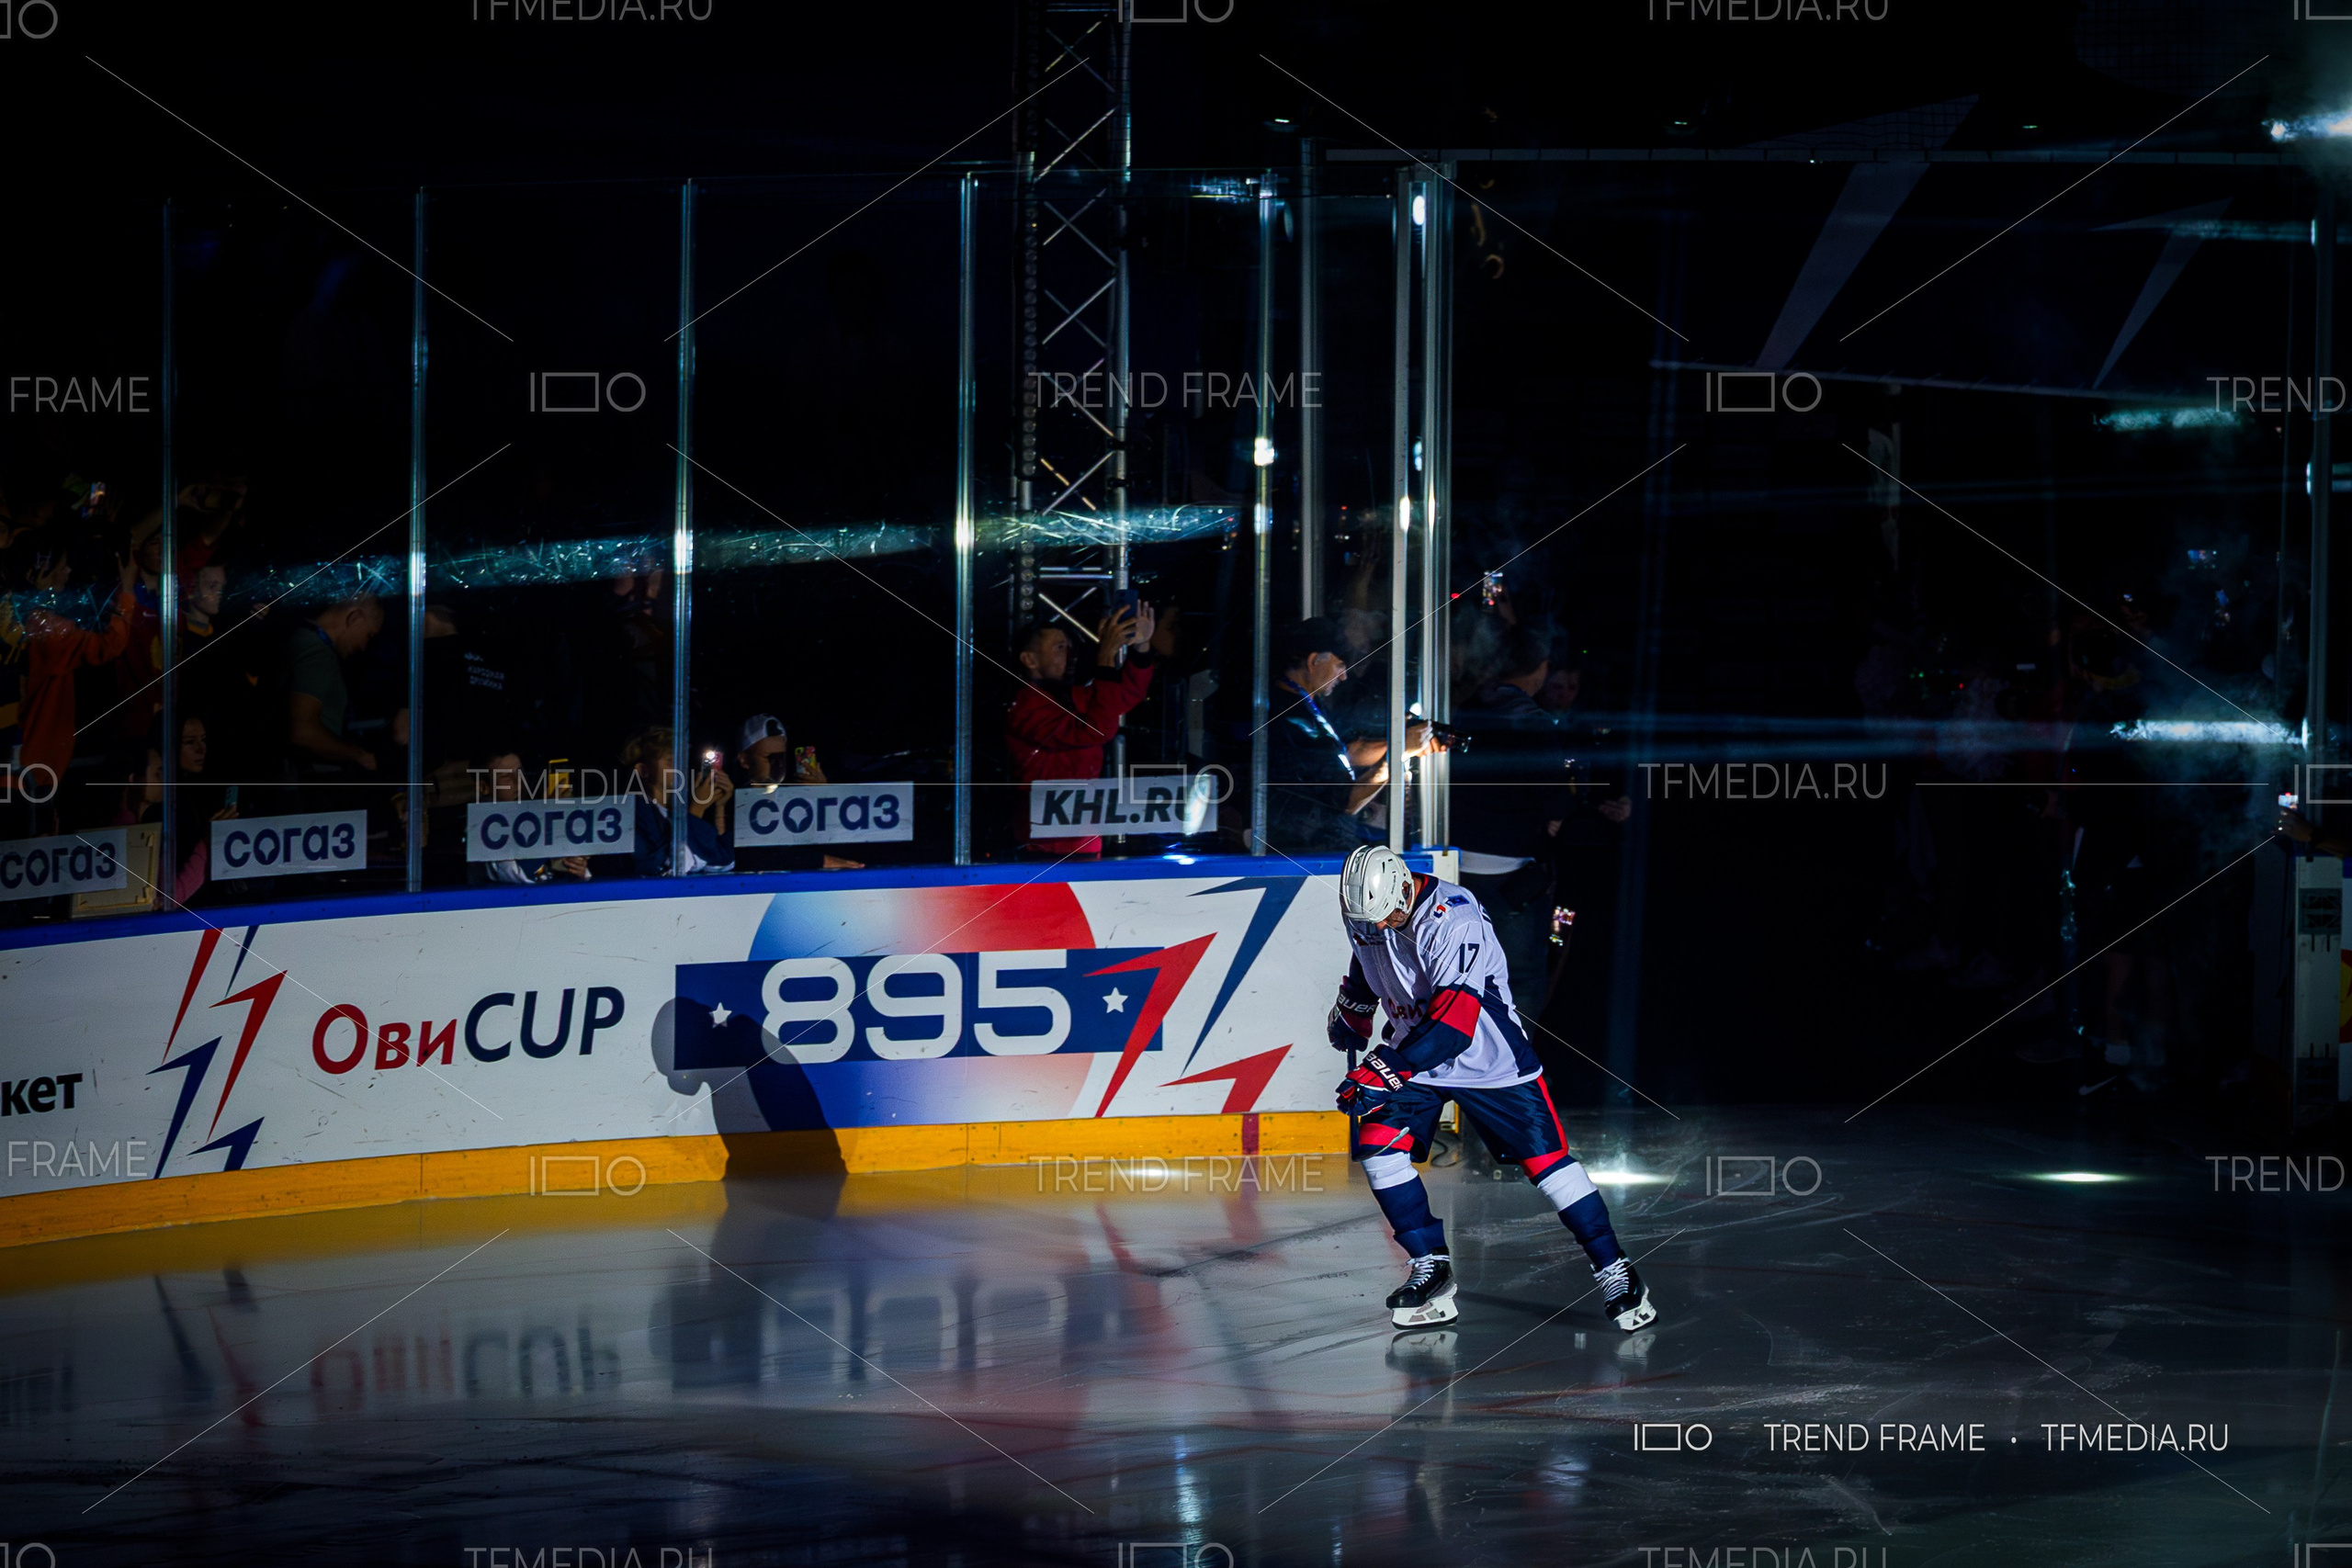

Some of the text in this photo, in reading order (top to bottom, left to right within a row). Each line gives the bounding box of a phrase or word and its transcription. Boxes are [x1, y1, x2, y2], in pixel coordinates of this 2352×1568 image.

[1458, 942, 1480, 974] 17
[312, 987, 626, 1075] ОвиCUP
[761, 952, 1072, 1065] 895
[1, 1073, 84, 1116] кет
